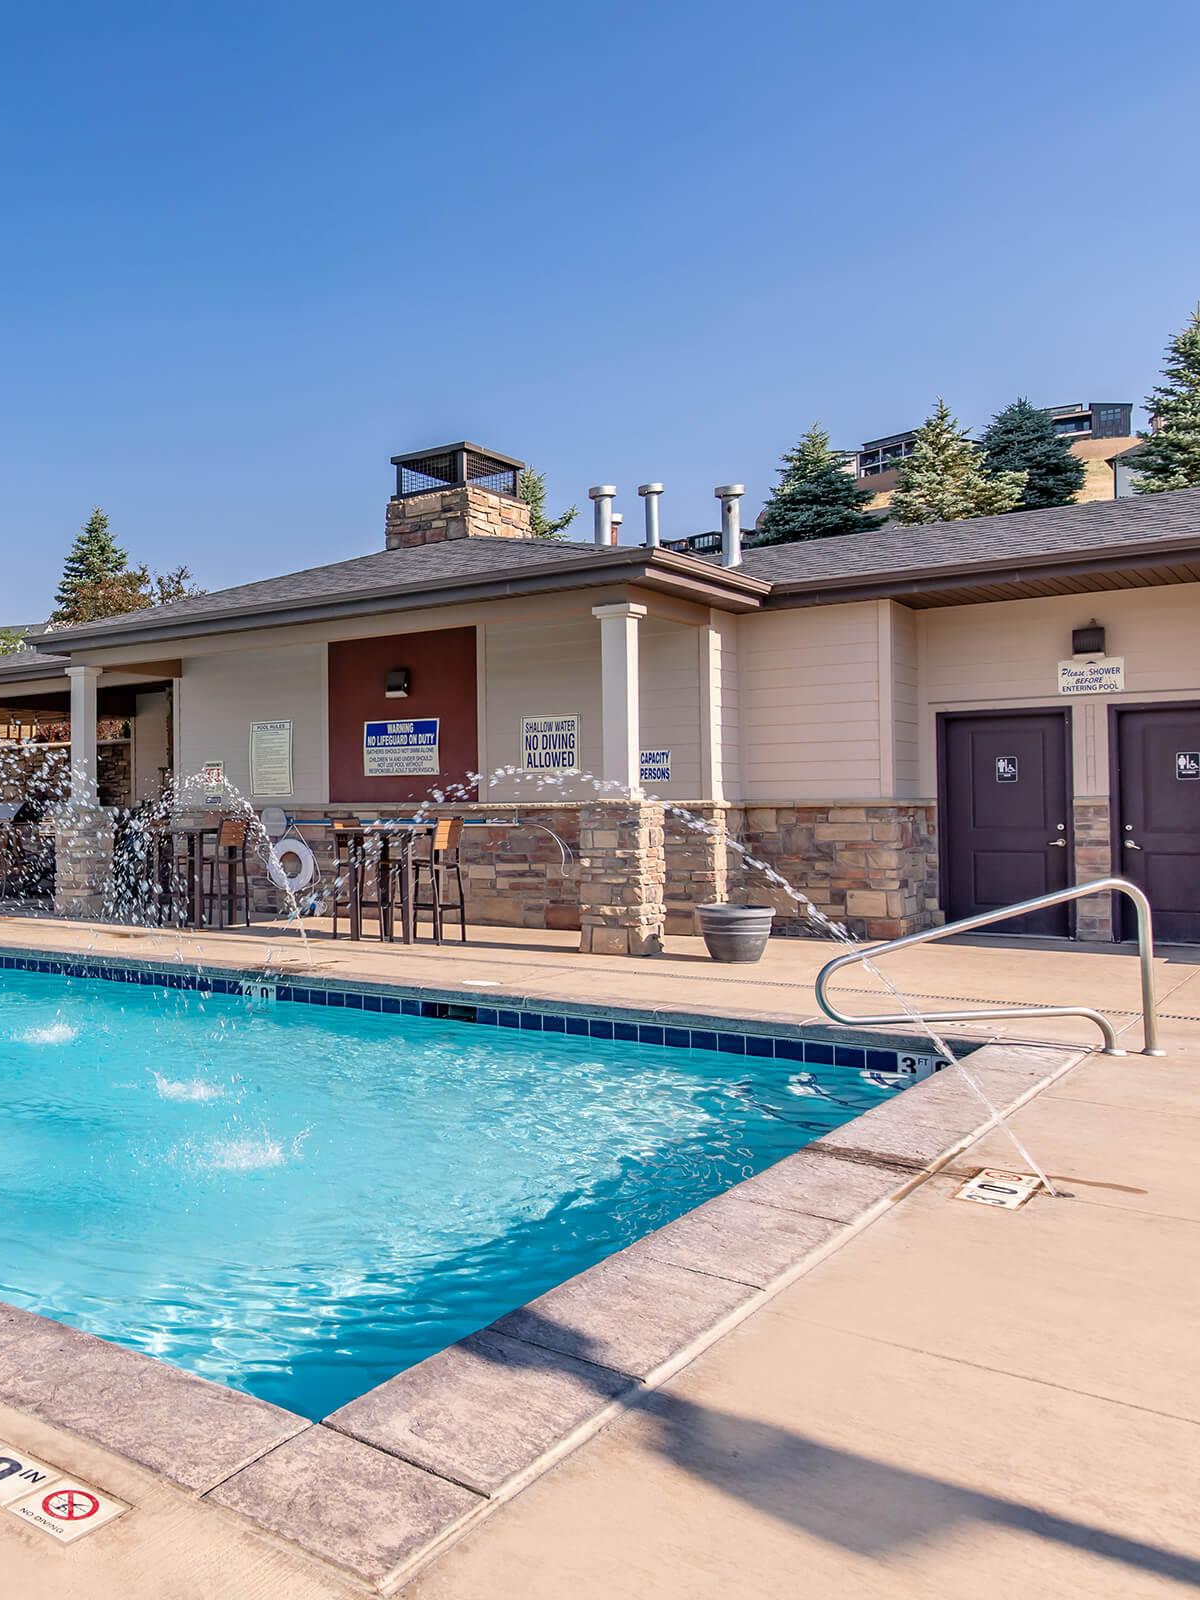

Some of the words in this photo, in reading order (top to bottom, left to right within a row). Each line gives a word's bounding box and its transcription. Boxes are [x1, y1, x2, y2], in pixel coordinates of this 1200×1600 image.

[1089, 667, 1120, 676] SHOWER
[1062, 684, 1097, 692] ENTERING
[387, 723, 414, 734] WARNING
[525, 720, 553, 733] SHALLOW
[554, 719, 575, 732] WATER
[367, 735, 376, 746] NO
[377, 734, 408, 746] LIFEGUARD
[409, 734, 417, 745] ON
[418, 733, 434, 744] DUTY
[525, 734, 539, 750] NO
[541, 732, 575, 750] DIVING
[526, 750, 575, 768] ALLOWED
[640, 751, 669, 764] CAPACITY
[640, 767, 670, 780] PERSONS
[901, 1056, 917, 1074] 3
[917, 1057, 929, 1066] FT
[18, 1468, 47, 1484] IN
[19, 1507, 34, 1517] NO
[33, 1515, 64, 1534] DIVING
